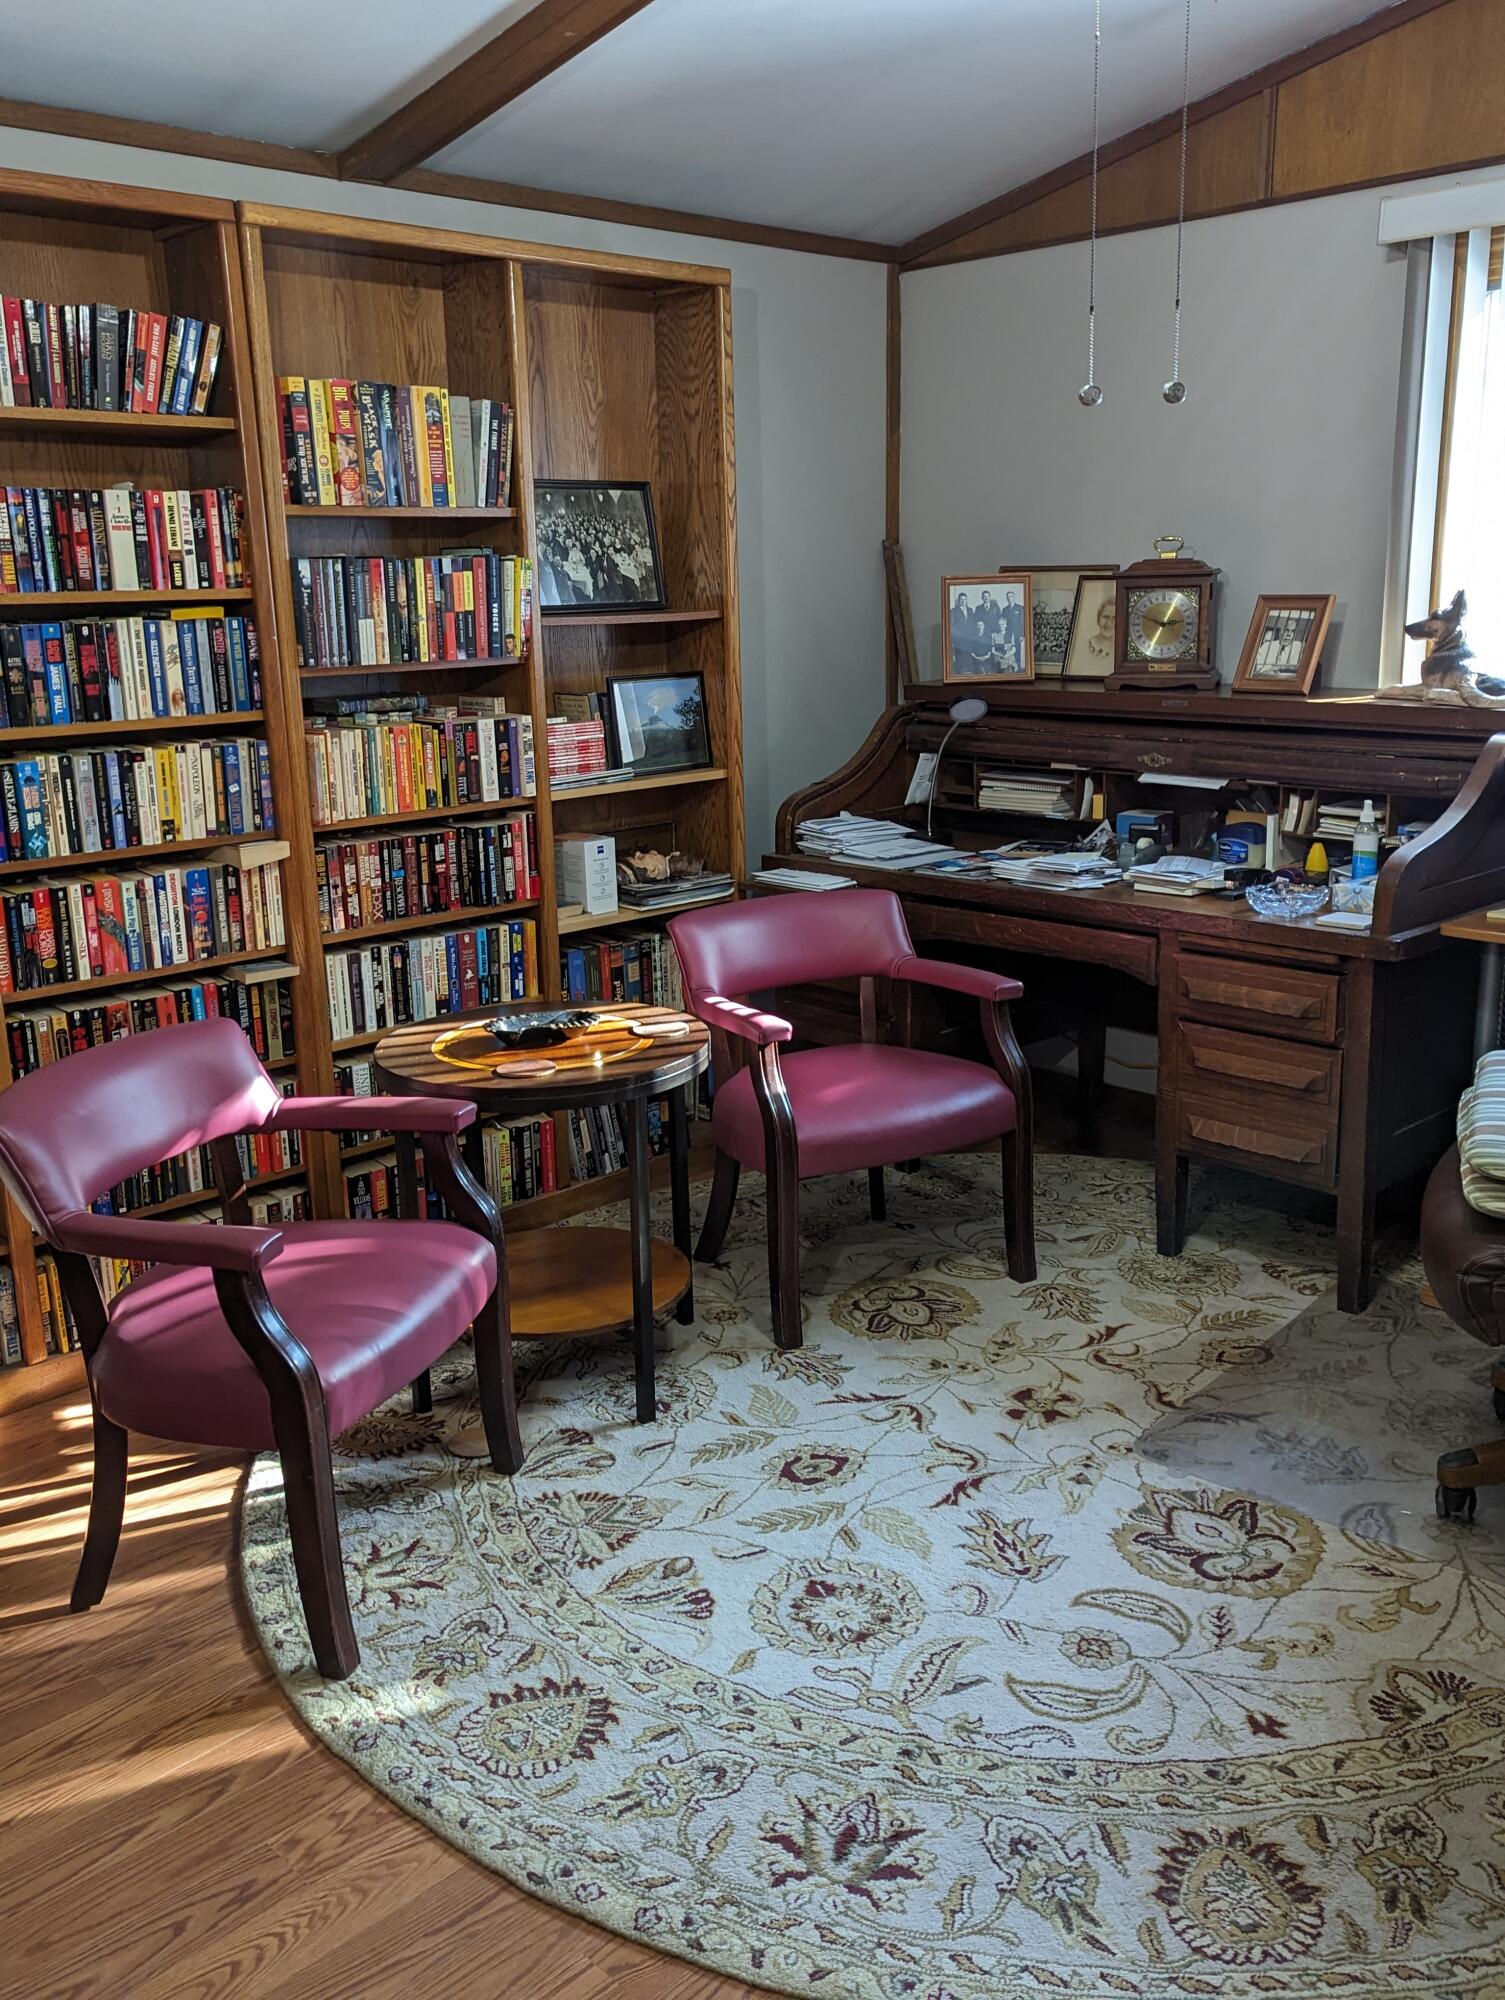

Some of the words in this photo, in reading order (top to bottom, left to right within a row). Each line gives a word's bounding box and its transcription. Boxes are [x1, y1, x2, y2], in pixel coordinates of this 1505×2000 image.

[332, 386, 348, 401] BIG
[337, 410, 351, 429] PULPS
[169, 873, 178, 906] DEIGHTON
[172, 907, 180, 933] LONDON
